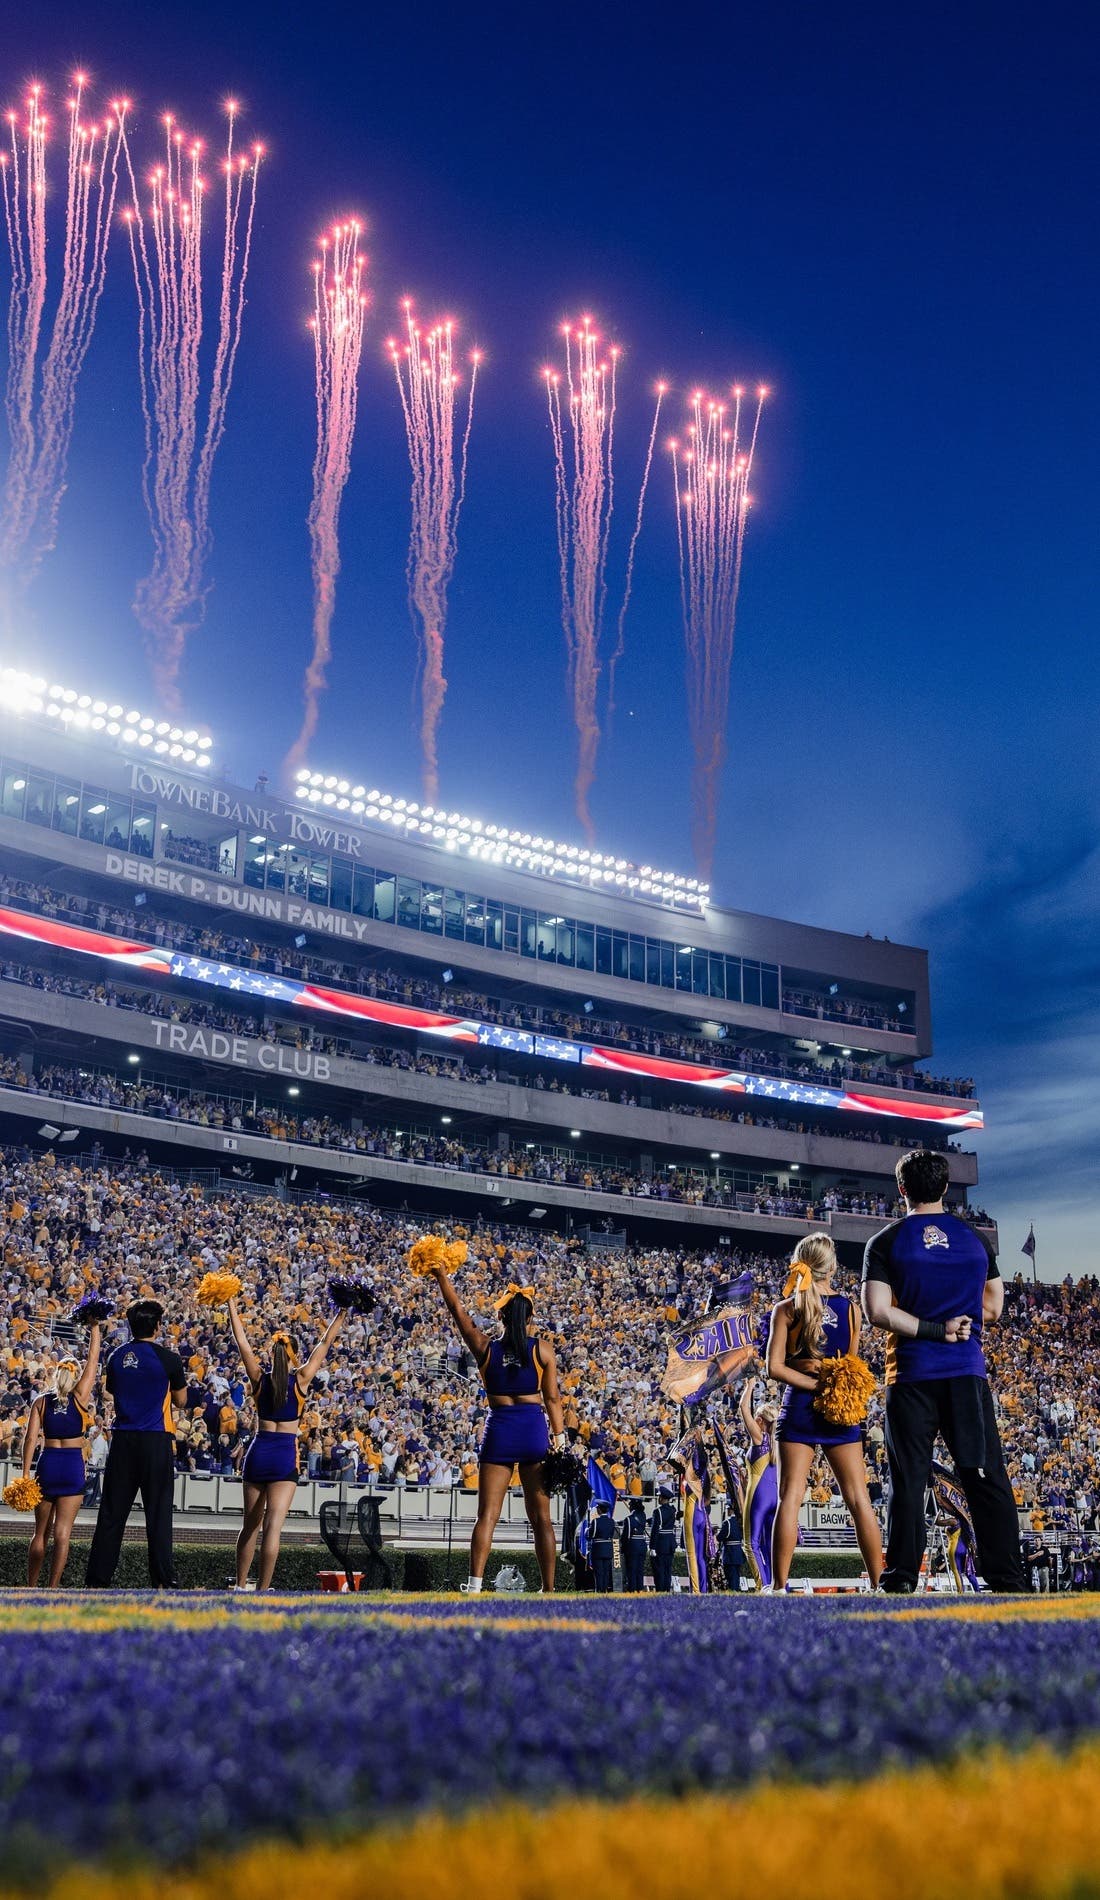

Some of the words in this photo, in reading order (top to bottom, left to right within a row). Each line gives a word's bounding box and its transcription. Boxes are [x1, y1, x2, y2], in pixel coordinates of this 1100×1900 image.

[284, 809, 362, 858] TOWER
[105, 854, 185, 894] DEREK
[190, 877, 211, 901] P.
[217, 885, 282, 919] DUNN
[287, 903, 368, 940] FAMILY
[151, 1020, 249, 1064] TRADE
[257, 1045, 331, 1080] CLUB
[612, 1538, 621, 1569] PIRATES
